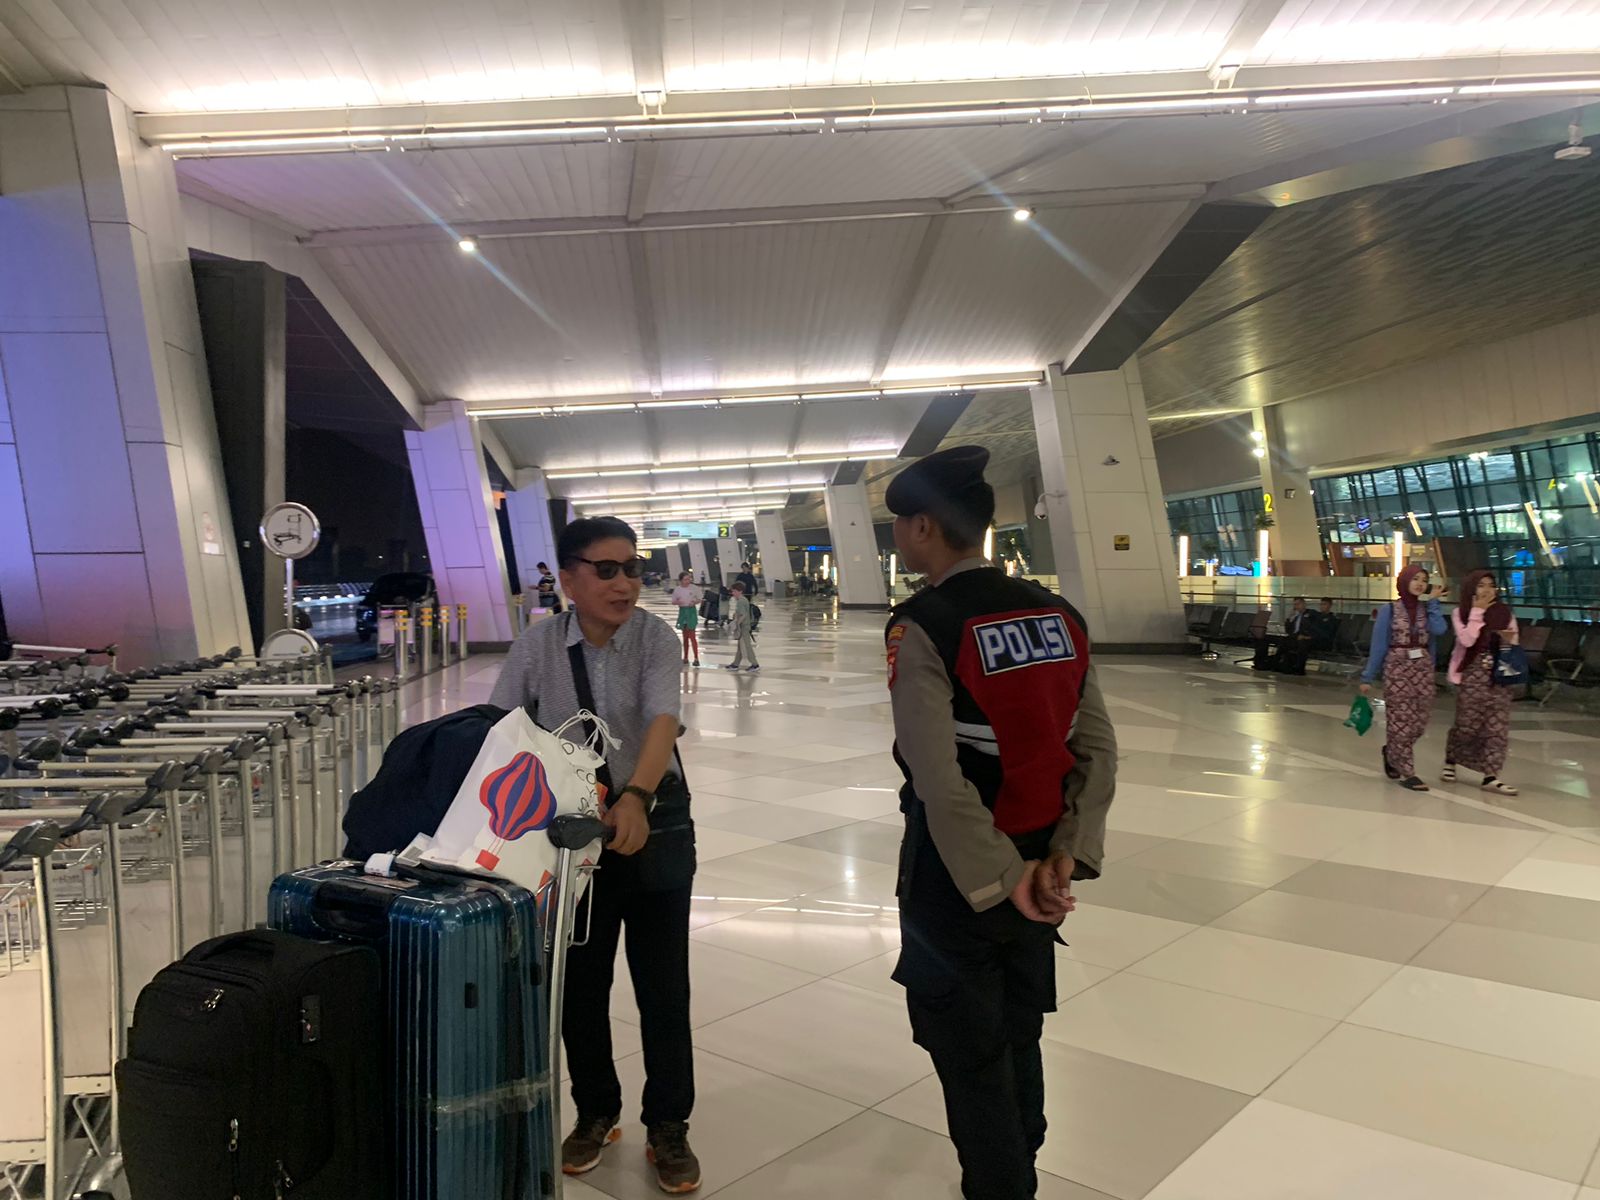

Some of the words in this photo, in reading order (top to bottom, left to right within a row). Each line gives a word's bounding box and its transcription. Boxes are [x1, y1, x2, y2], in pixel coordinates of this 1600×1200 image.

[1263, 493, 1273, 511] 2
[720, 527, 728, 536] 2
[980, 618, 1073, 669] POLISI
